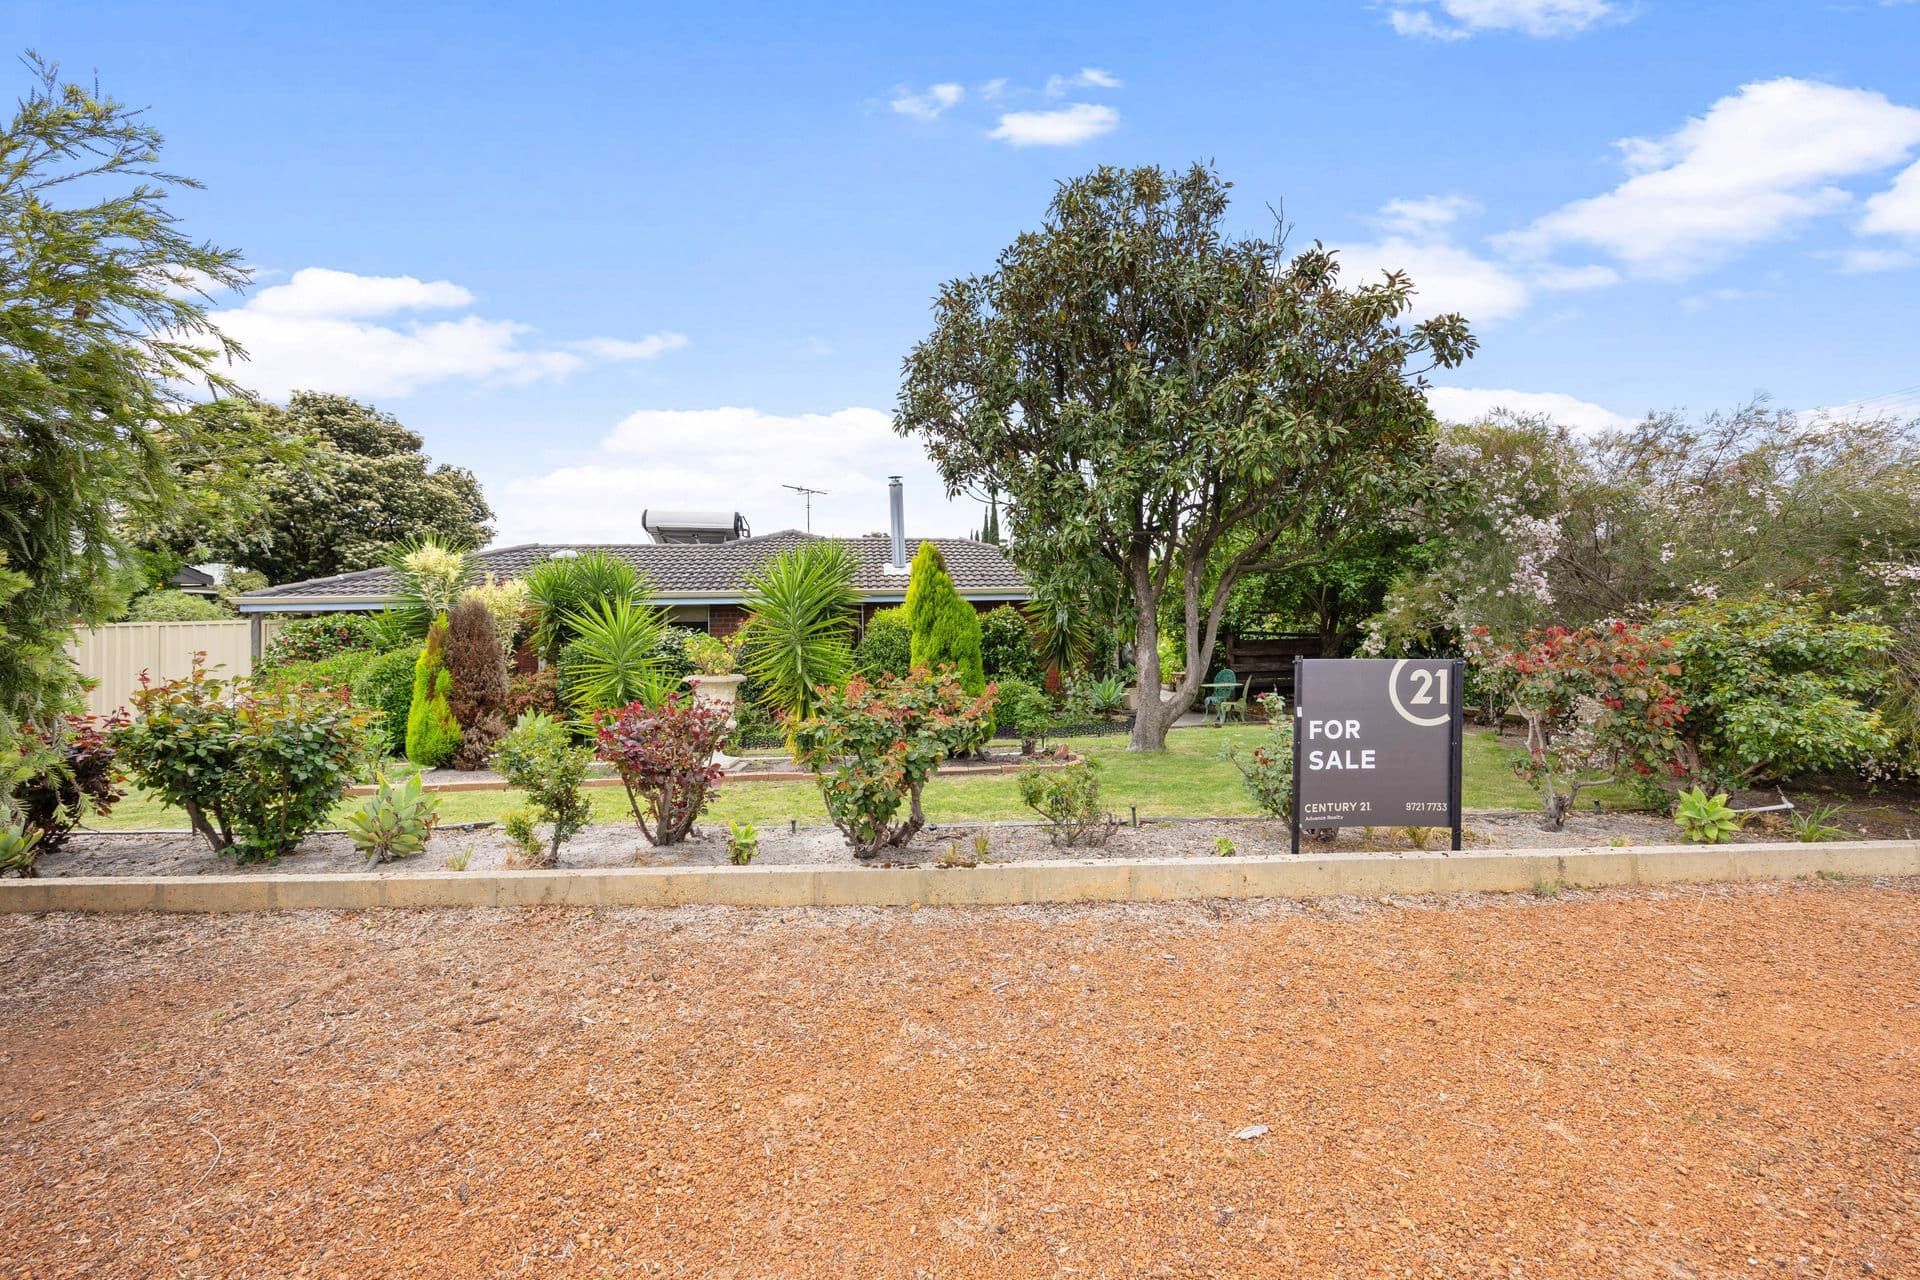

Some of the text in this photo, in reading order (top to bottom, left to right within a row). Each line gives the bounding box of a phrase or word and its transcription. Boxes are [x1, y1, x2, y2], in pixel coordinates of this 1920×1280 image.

[1309, 719, 1361, 740] FOR
[1309, 749, 1376, 770] SALE
[1304, 802, 1357, 814] CENTURY
[1405, 802, 1448, 812] 9721 7733
